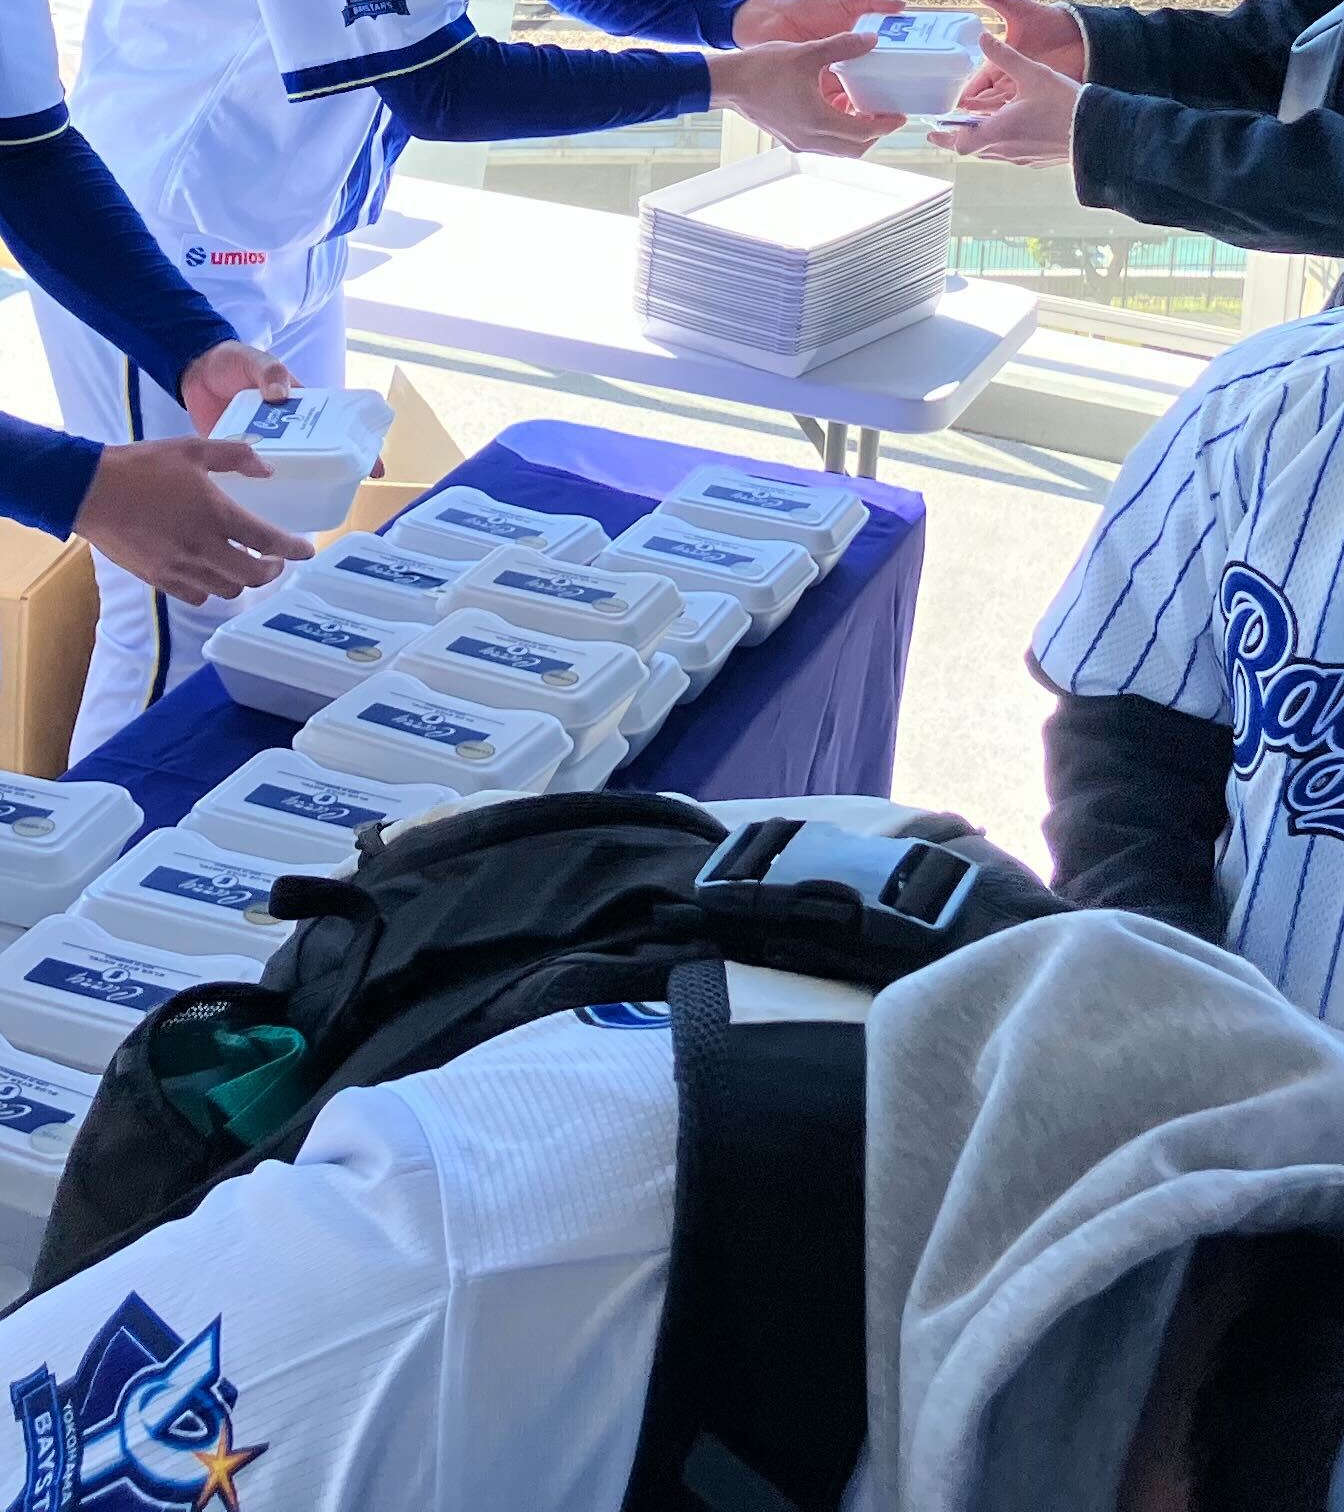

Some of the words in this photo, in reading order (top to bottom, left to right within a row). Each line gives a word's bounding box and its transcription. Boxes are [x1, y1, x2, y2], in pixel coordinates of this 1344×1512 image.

[209, 249, 267, 266] umios
[279, 793, 352, 820] Curry
[177, 876, 253, 905] Curry
[65, 970, 145, 1002] Curry
